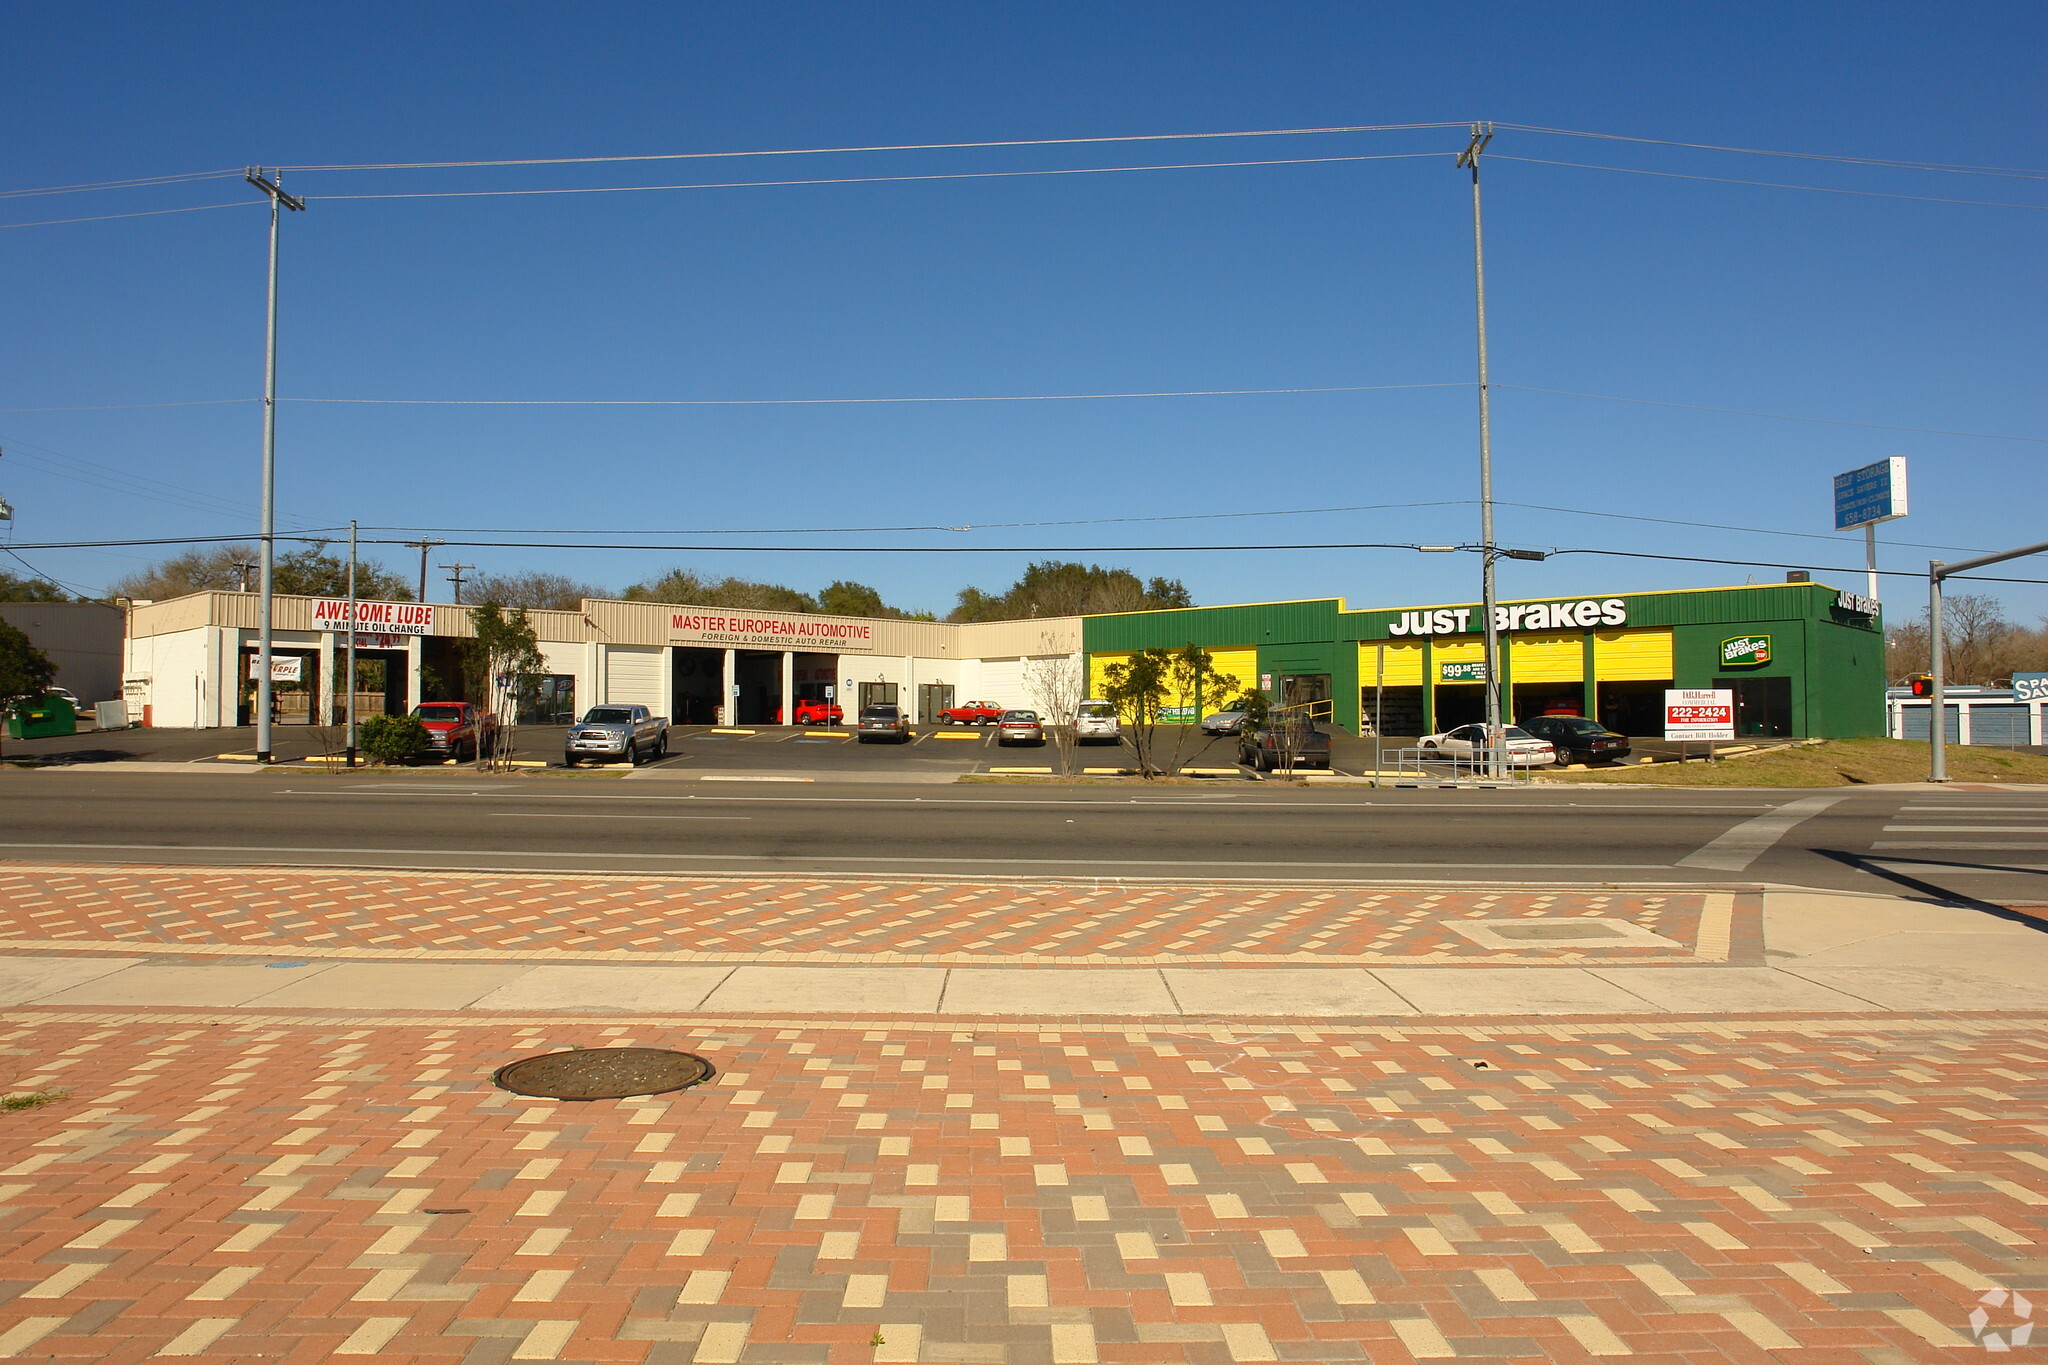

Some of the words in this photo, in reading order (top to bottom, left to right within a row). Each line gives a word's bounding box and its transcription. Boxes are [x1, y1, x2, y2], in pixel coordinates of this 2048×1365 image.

[1835, 475, 1853, 489] SELF
[1857, 462, 1889, 482] STORAGE
[1845, 505, 1881, 524] 658-8734
[1838, 590, 1854, 610] JUST
[315, 600, 393, 623] AWESOME
[397, 606, 432, 625] LUBE
[1389, 608, 1470, 636] JUST
[324, 620, 330, 630] 9
[372, 623, 386, 632] OIL
[389, 624, 425, 634] CHANGE
[672, 614, 726, 632] MASTER
[729, 617, 796, 635] EUROPEAN
[798, 622, 870, 639] AUTOMOTIVE
[701, 632, 740, 642] FOREIGN
[751, 635, 793, 644] DOMESTIC
[795, 637, 817, 645] AUTO
[818, 638, 847, 647] REPAIR
[1724, 638, 1750, 652] JUST
[1725, 640, 1768, 660] Brakes
[1442, 665, 1472, 677] $99.88
[1671, 707, 1726, 717] 222-2424
